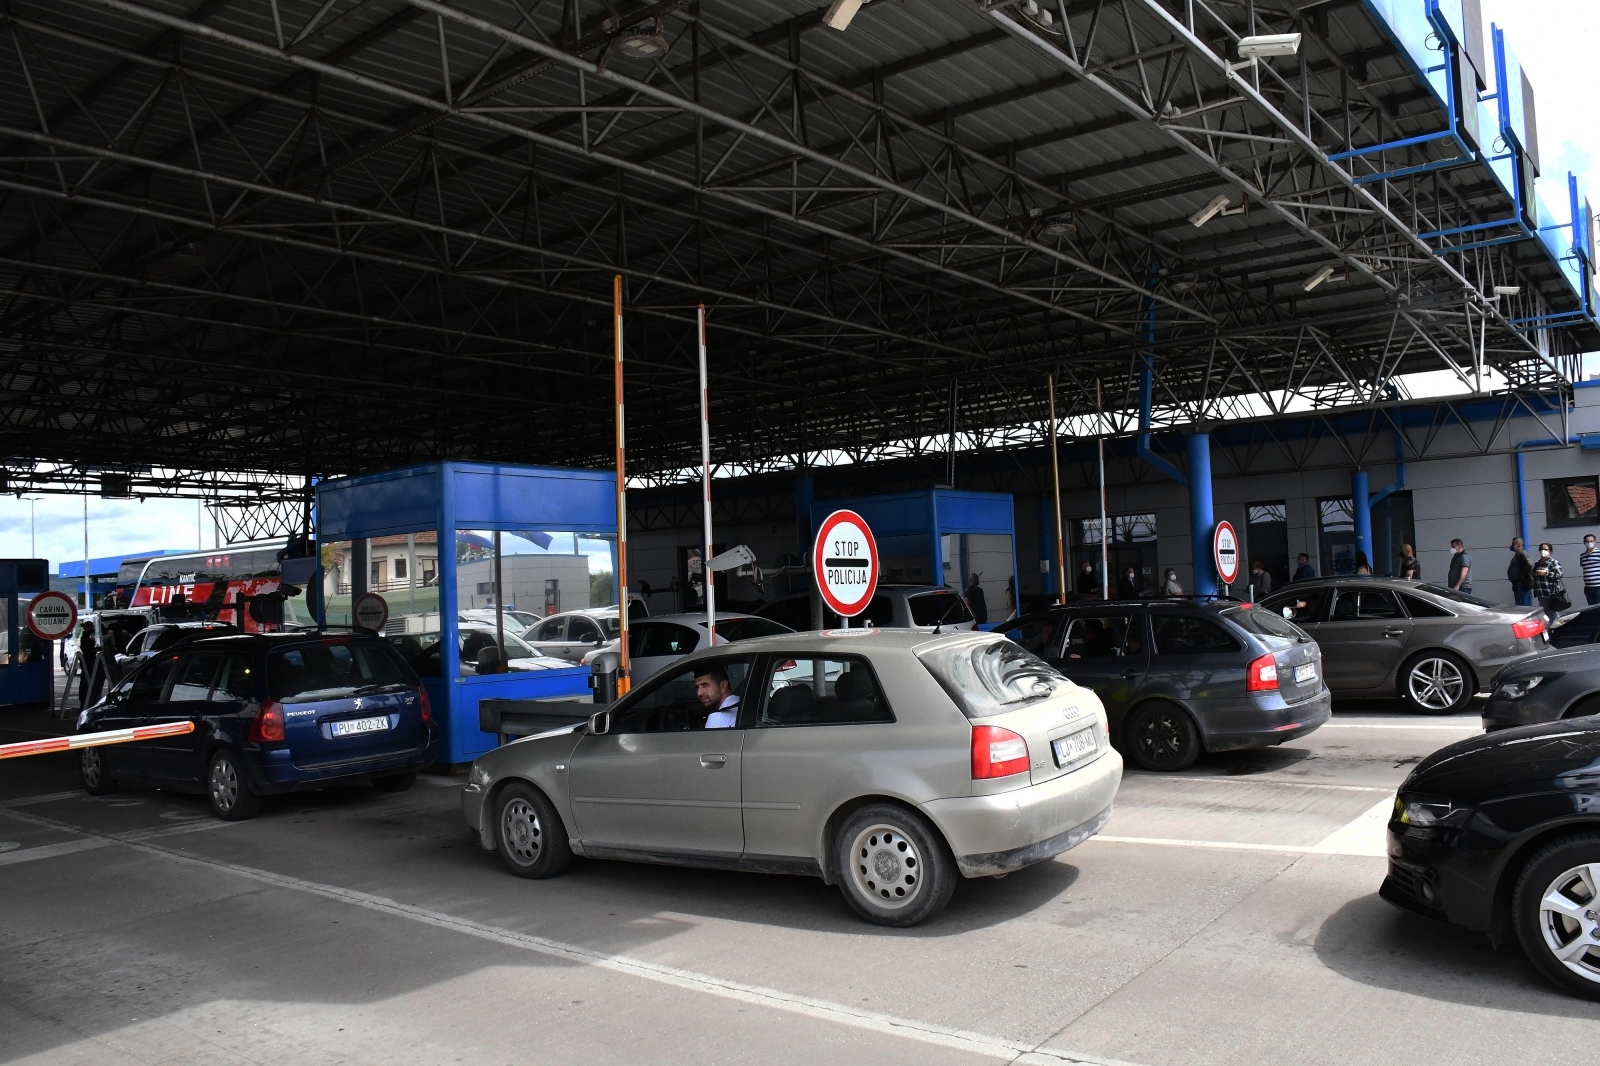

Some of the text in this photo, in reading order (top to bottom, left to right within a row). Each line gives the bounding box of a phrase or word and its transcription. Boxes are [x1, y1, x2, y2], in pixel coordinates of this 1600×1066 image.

[834, 540, 859, 557] STOP
[1221, 538, 1231, 549] STOP
[828, 569, 867, 585] POLICIJA
[150, 584, 195, 604] LINE
[39, 605, 66, 614] CARINA
[38, 617, 67, 626] DOUANE
[286, 709, 316, 717] PEUGEOT
[339, 718, 387, 734] PU 402-ZK
